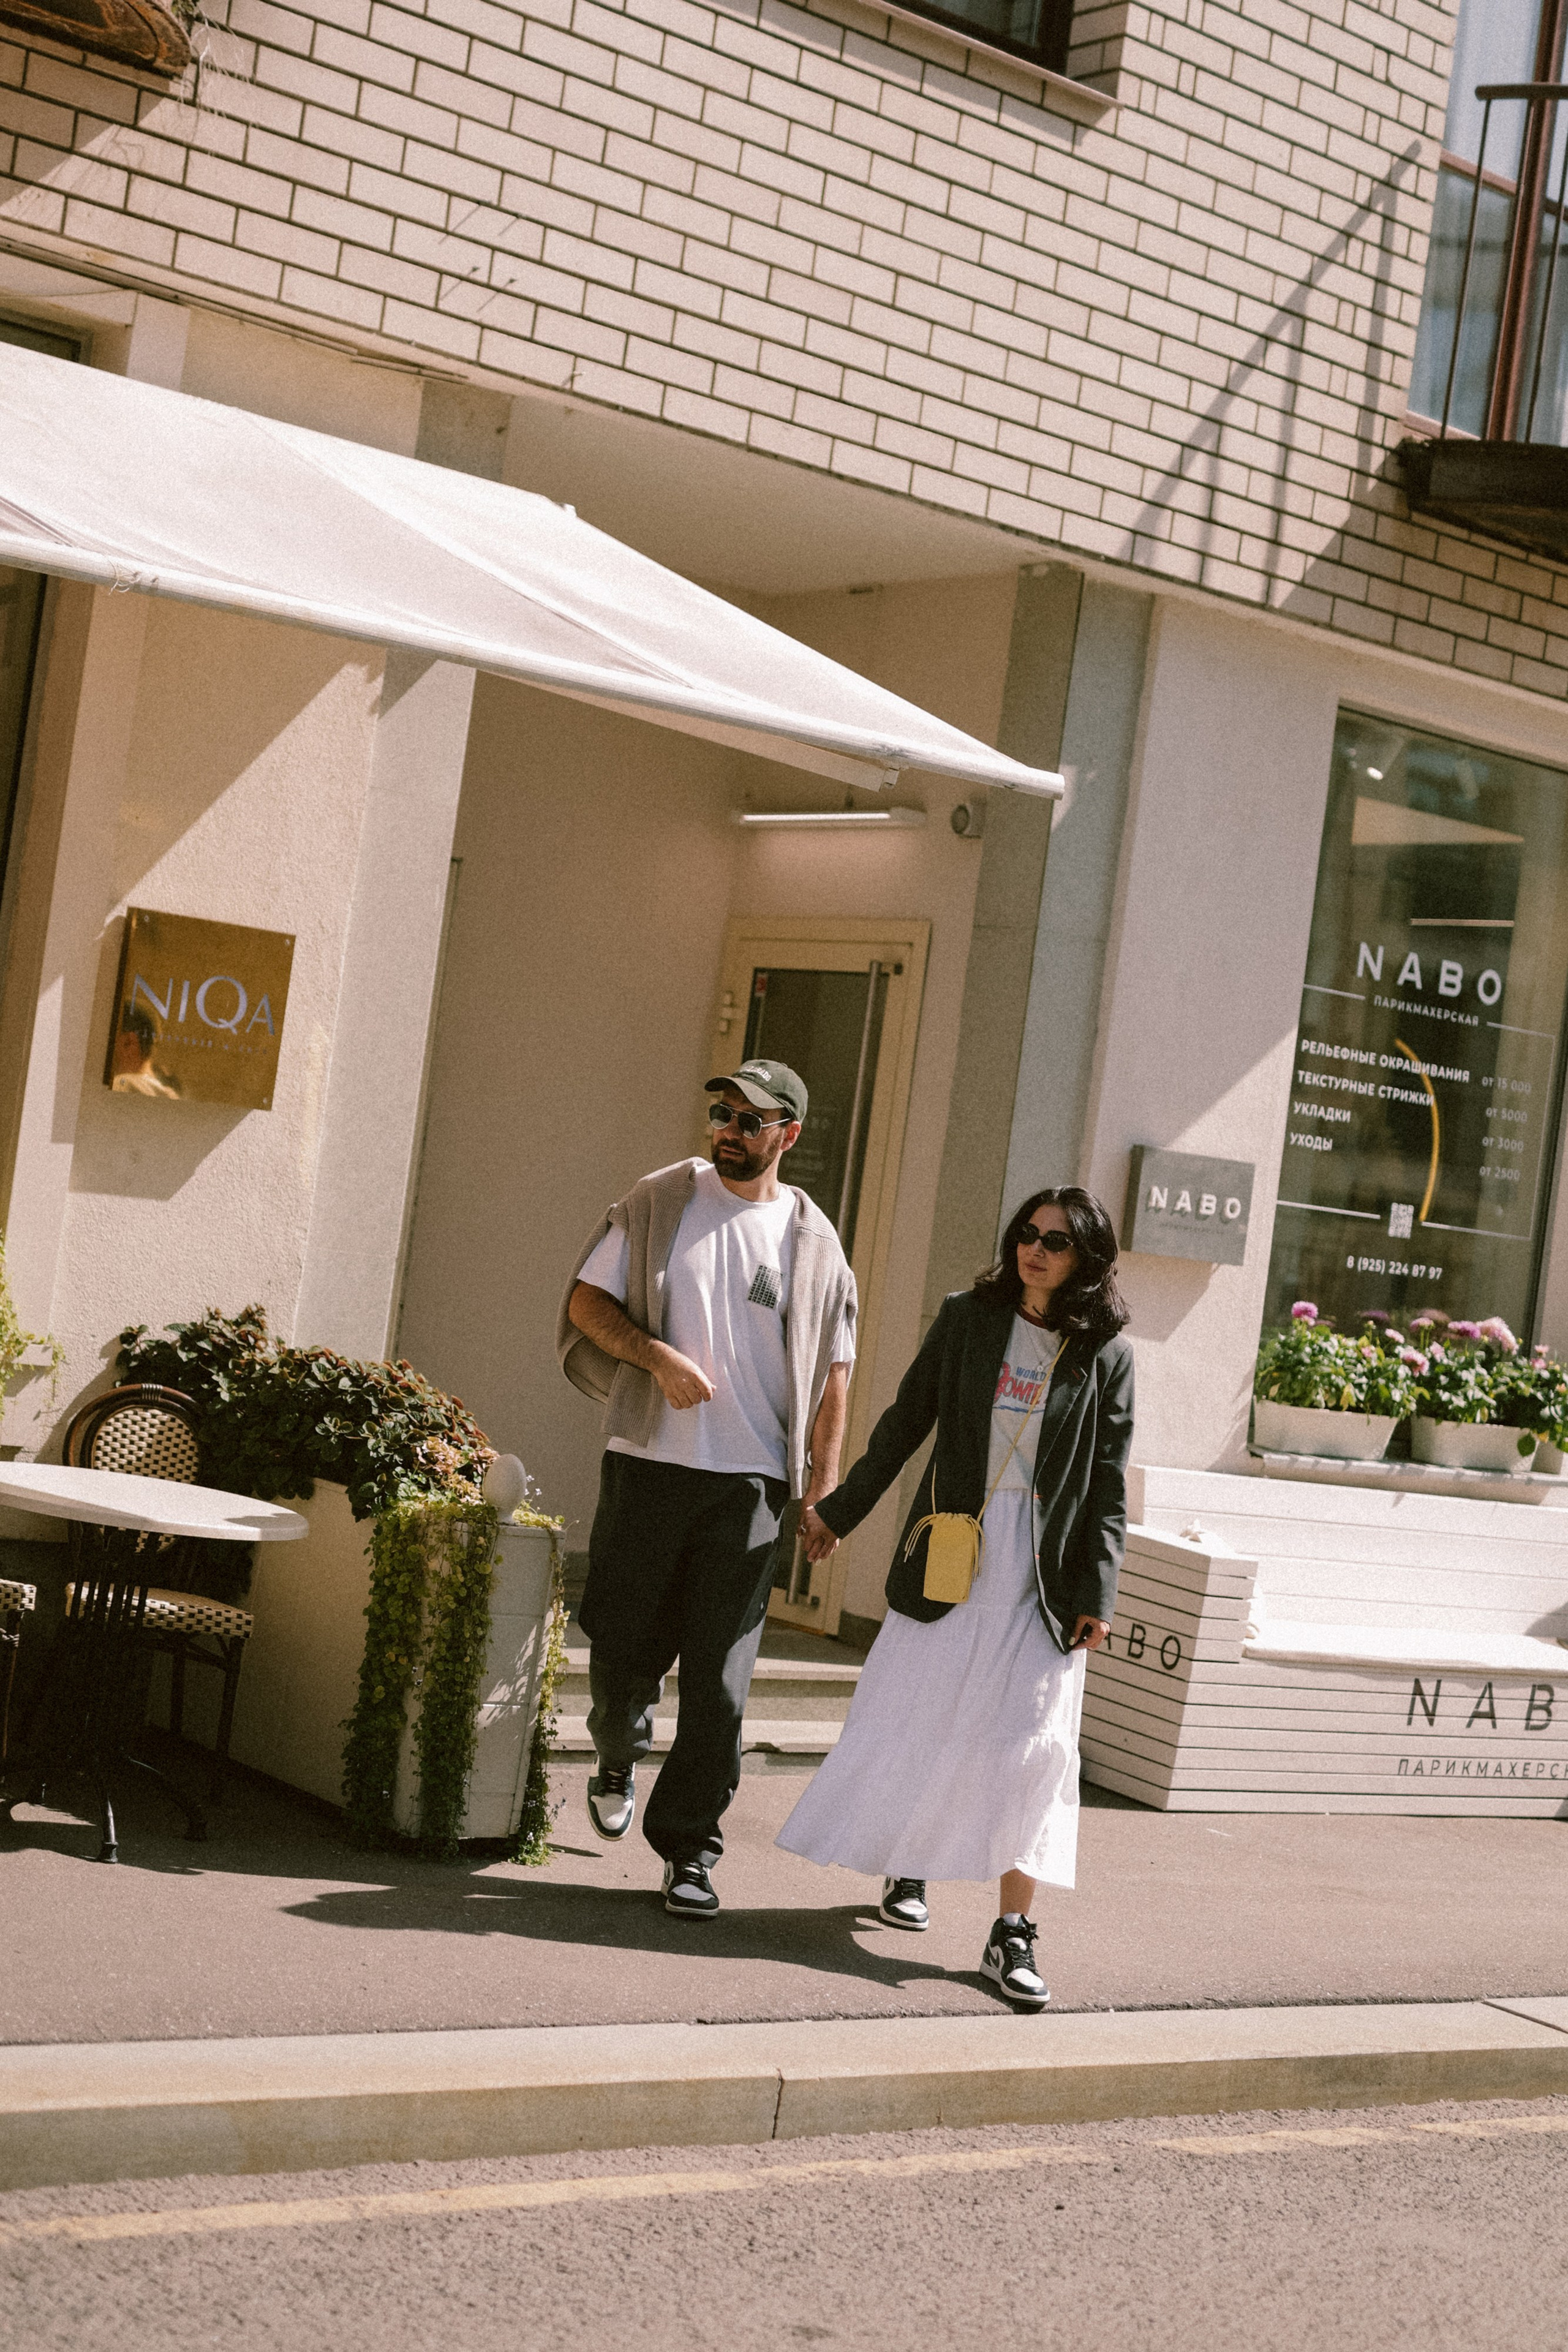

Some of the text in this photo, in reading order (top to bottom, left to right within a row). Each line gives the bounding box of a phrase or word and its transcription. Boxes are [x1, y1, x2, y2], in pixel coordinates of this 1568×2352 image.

[1357, 941, 1502, 1006] NABO
[130, 974, 275, 1035] NIQA
[1374, 995, 1479, 1027] ПАРИКМАХЕРСКАЯ
[1302, 1039, 1376, 1066] РЕЛЬЕФНЫЕ
[1379, 1054, 1470, 1083] ОКРАШИВАНИЯ
[1498, 1077, 1507, 1090] 15
[1511, 1080, 1531, 1095] 000
[1298, 1070, 1375, 1096] ТЕКСТУРНЫЕ
[1378, 1085, 1434, 1106] СТРИЖКИ
[1501, 1107, 1528, 1124] 5000
[1294, 1101, 1351, 1123] УКЛАДКИ
[1498, 1137, 1524, 1153] 3000
[1289, 1132, 1333, 1152] УХОДЫ
[1494, 1166, 1520, 1182] 2500
[1148, 1186, 1242, 1219] NABO
[1347, 1256, 1442, 1280] 8 (925) 224 87 97
[1016, 1366, 1047, 1382] WORLD
[1407, 1678, 1555, 1731] NAB
